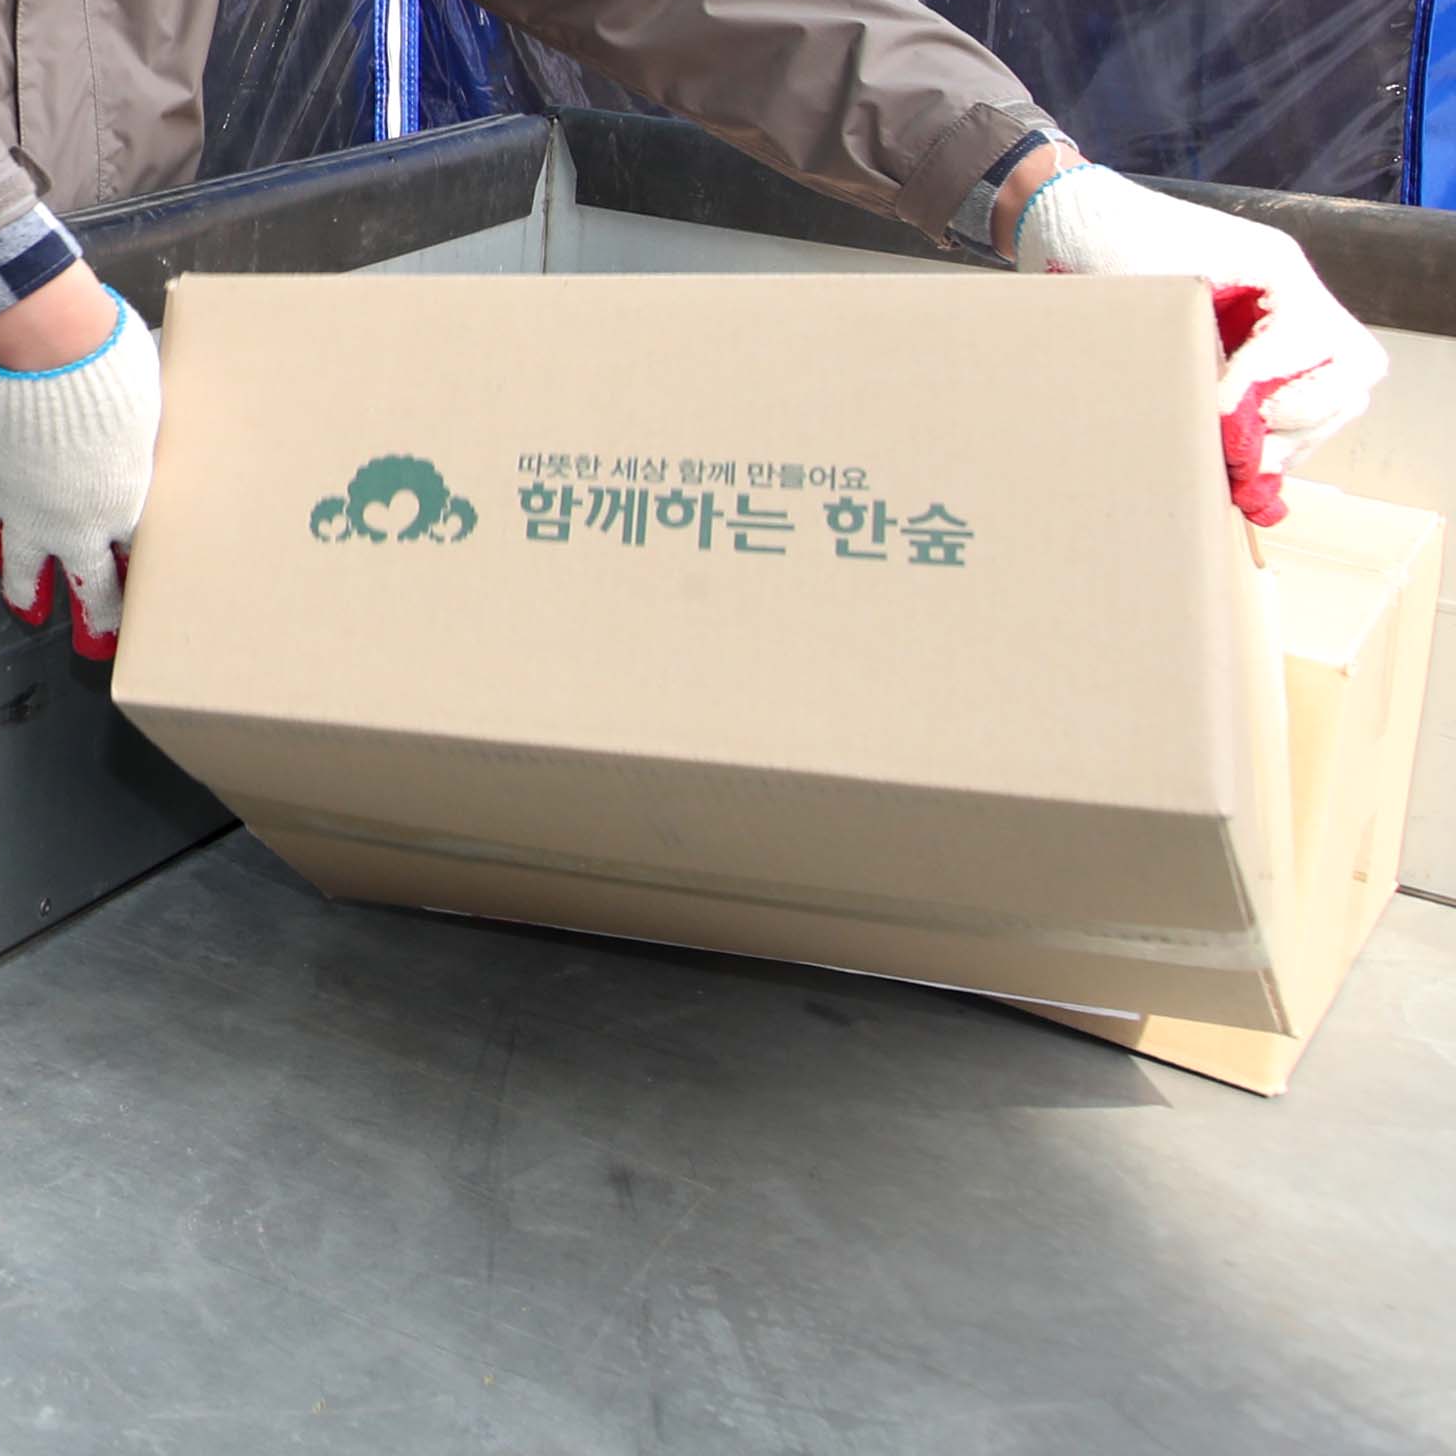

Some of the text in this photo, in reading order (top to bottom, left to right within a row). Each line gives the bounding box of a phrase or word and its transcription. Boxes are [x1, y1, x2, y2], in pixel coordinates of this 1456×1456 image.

[517, 451, 870, 492] 따뜻한 세상 함께 만들어요
[517, 481, 976, 569] 함께하는 한숲
